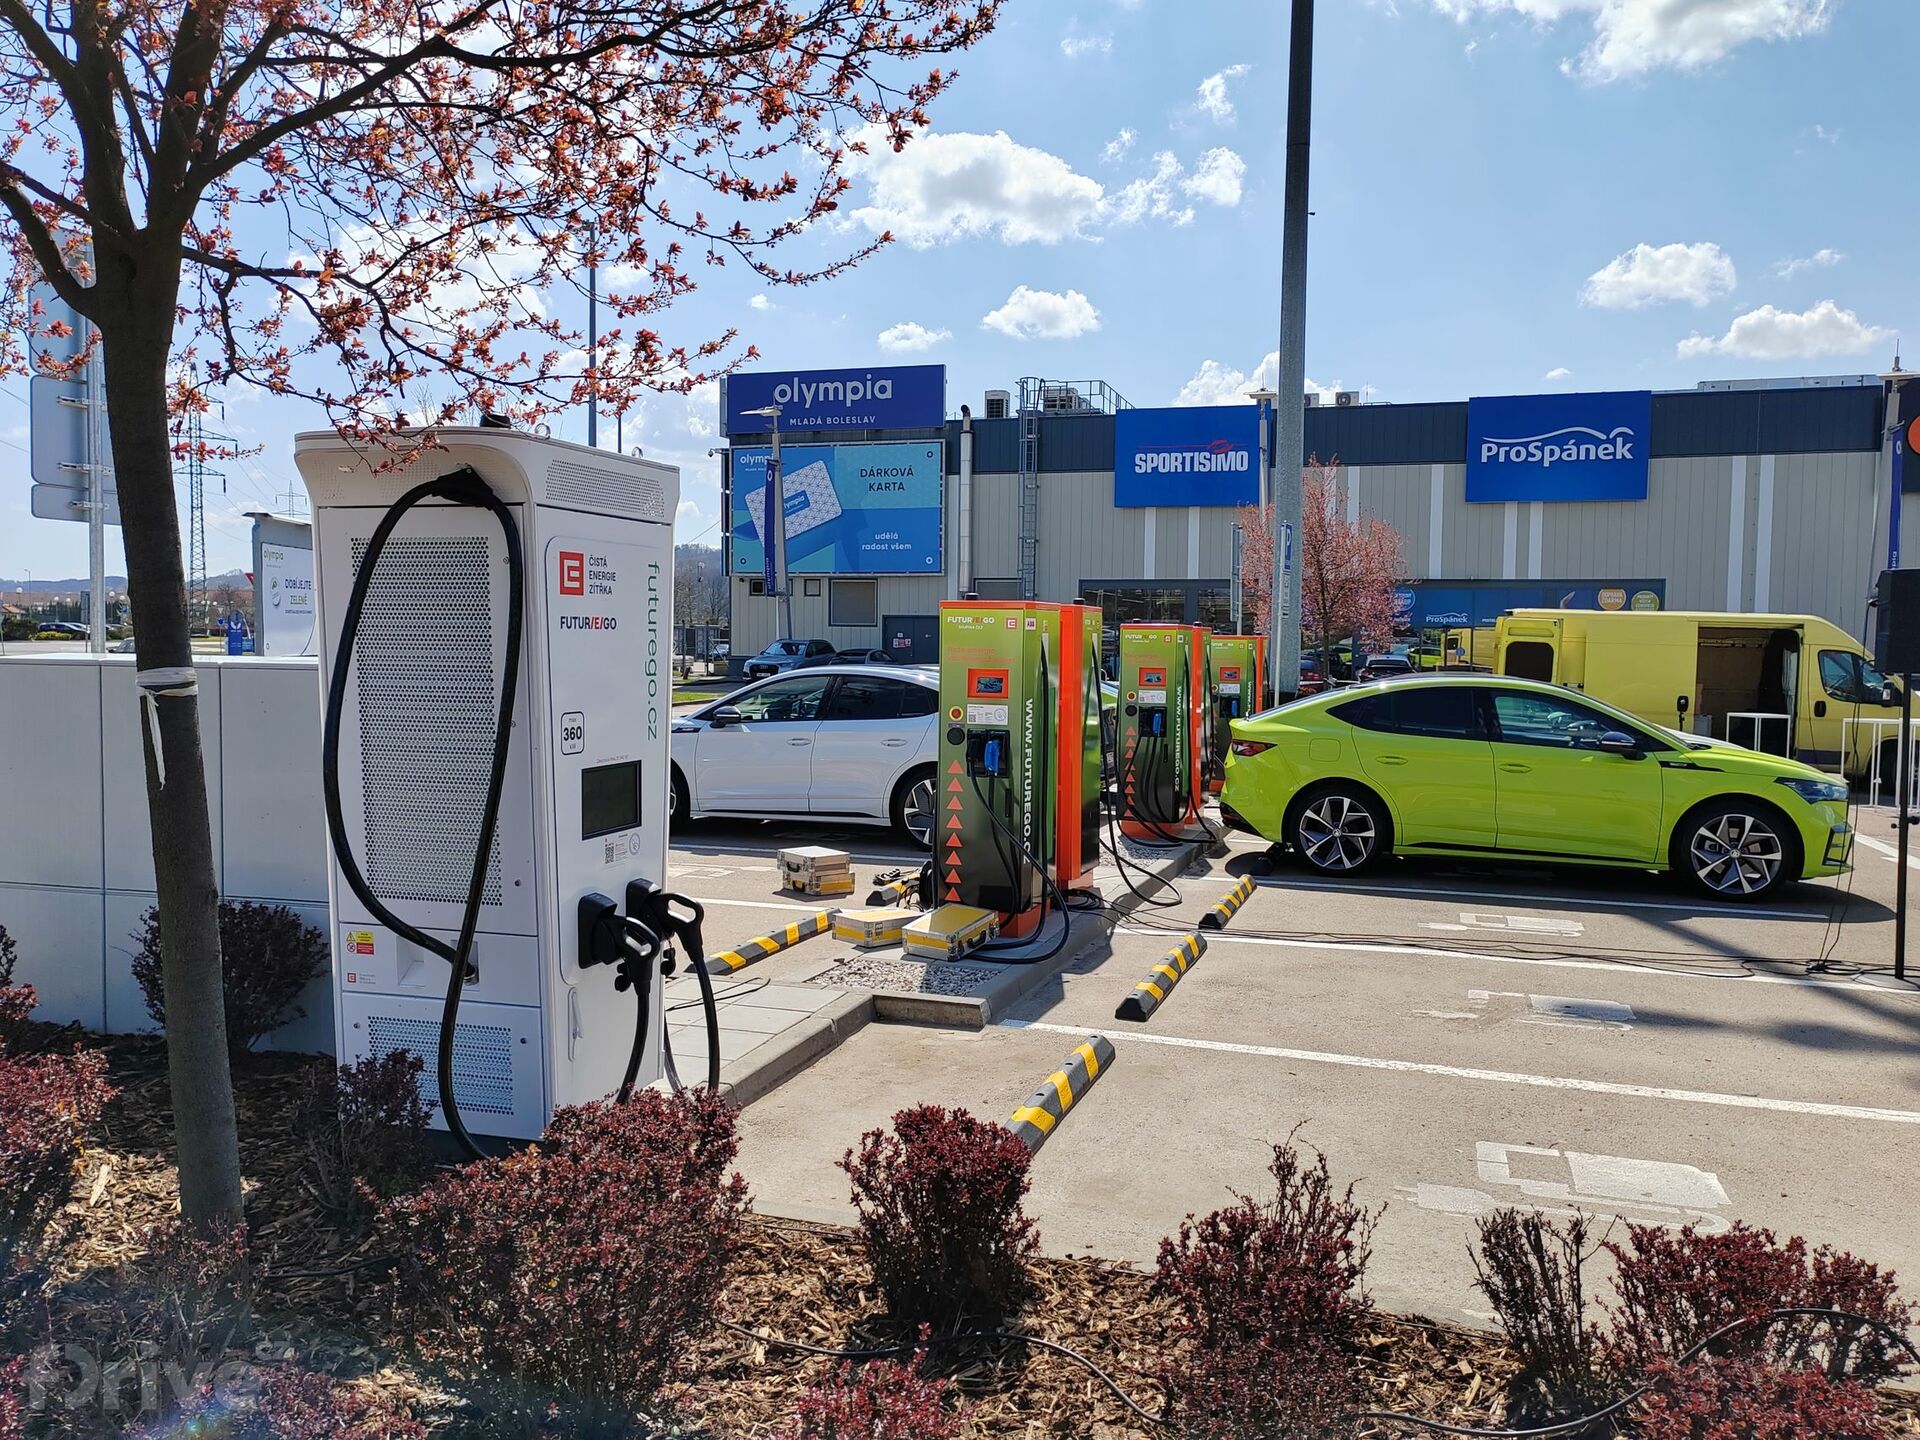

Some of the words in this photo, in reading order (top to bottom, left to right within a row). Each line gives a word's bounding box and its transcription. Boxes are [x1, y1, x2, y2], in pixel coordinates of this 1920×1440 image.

[774, 374, 892, 408] olympia
[789, 415, 822, 426] MLADÁ
[826, 415, 876, 425] BOLESLAV
[1480, 438, 1634, 467] ProSpánek
[740, 453, 774, 465] olympi
[1134, 450, 1249, 474] SPORTISIMO
[860, 465, 914, 478] DÁRKOVÁ
[868, 482, 905, 492] KARTA
[875, 531, 898, 541] udělá
[861, 542, 888, 551] radost
[891, 541, 912, 551] všem
[588, 554, 608, 567] ČISTÁ
[588, 570, 617, 582] ENERGIE
[588, 584, 613, 595] ZÍTŘKA
[1425, 616, 1468, 624] ProSpánek
[644, 561, 660, 740] futurego.cz
[563, 725, 582, 741] 360
